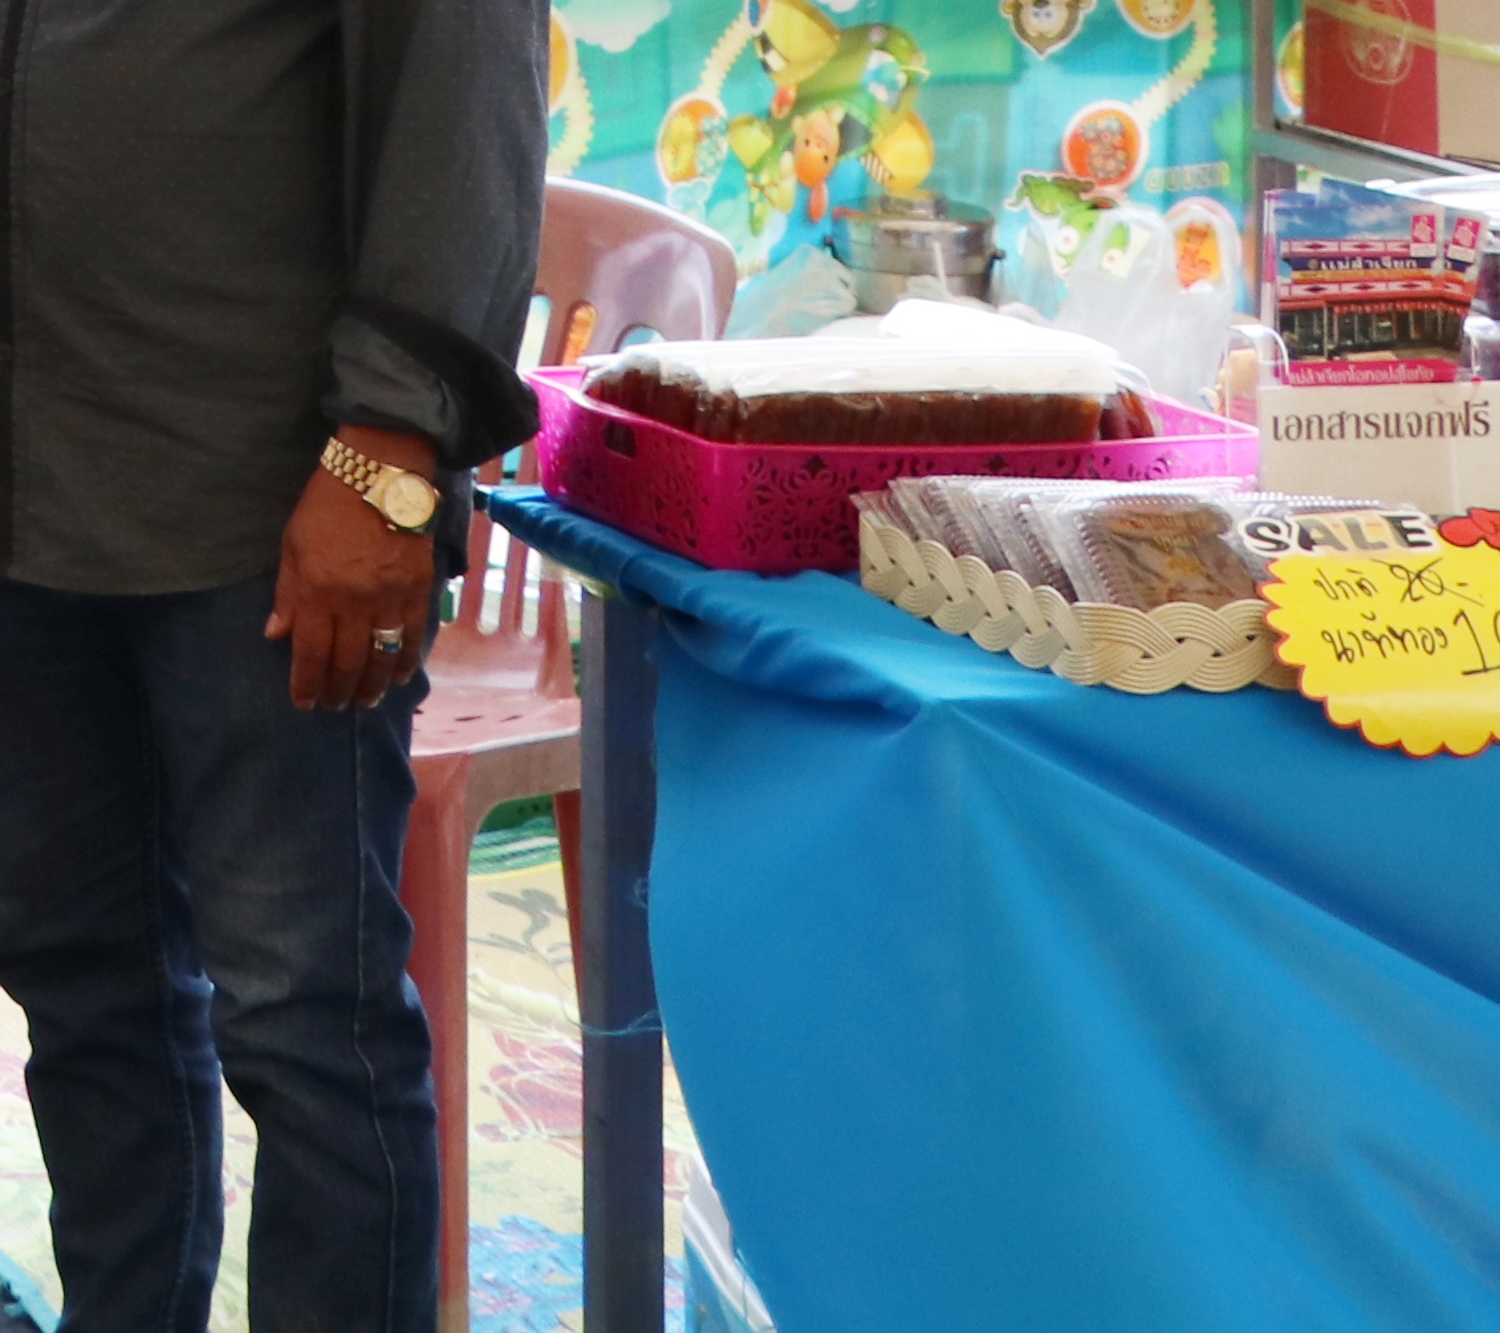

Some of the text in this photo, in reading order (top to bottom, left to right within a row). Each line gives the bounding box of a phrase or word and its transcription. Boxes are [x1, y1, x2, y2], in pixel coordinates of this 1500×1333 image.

[1271, 399, 1492, 442] เอกสารแจกฟรี
[1241, 512, 1437, 556] SALE
